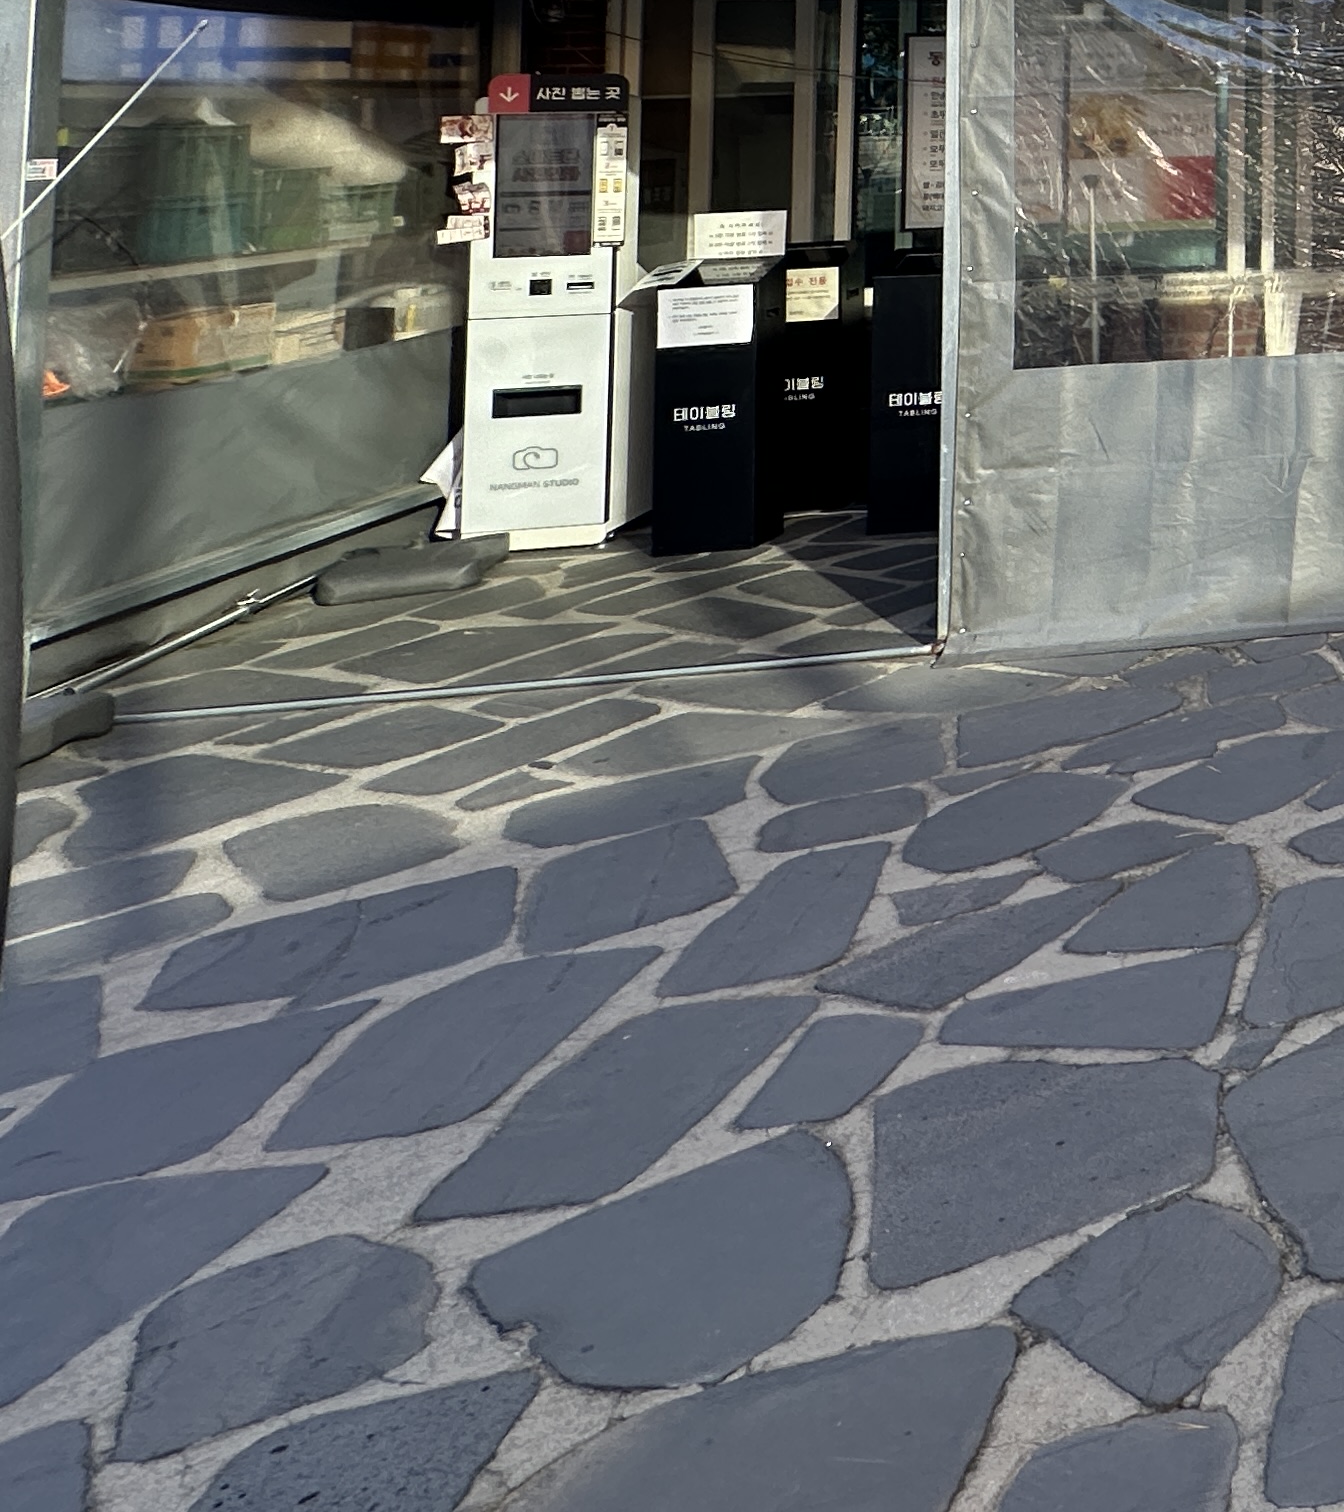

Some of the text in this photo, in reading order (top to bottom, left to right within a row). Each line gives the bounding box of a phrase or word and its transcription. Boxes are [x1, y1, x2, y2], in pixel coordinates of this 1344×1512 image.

[536, 86, 566, 101] 사진
[604, 86, 621, 101] 곳
[673, 403, 737, 422] 테이블링
[683, 422, 727, 432] TABLING
[543, 477, 580, 489] STUDIO
